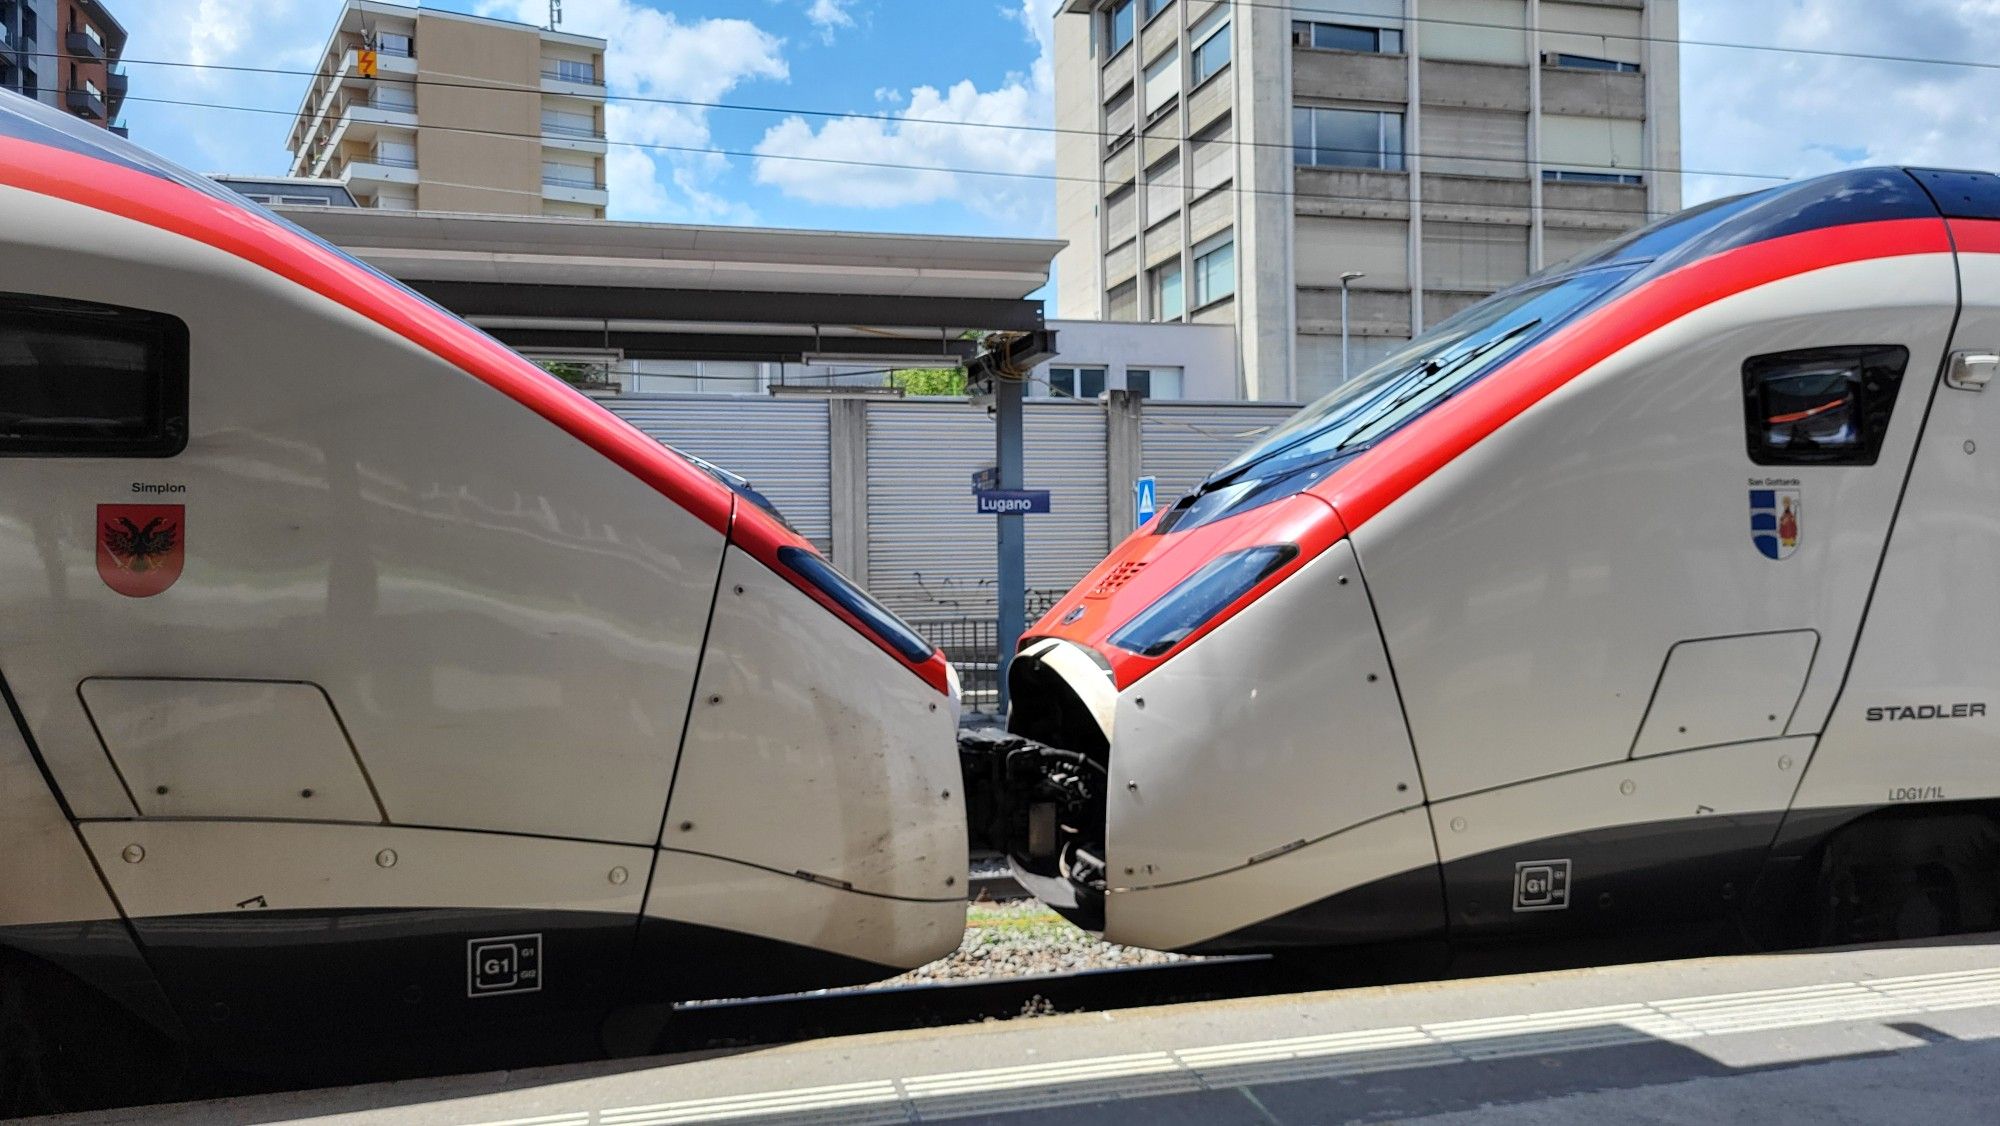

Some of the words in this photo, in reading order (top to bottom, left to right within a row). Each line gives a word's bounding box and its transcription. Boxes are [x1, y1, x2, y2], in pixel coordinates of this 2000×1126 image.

[131, 482, 186, 495] Simplon
[981, 497, 1032, 513] Lugano
[1865, 703, 1986, 721] STADLER
[1526, 879, 1546, 893] G1
[484, 958, 509, 974] G1
